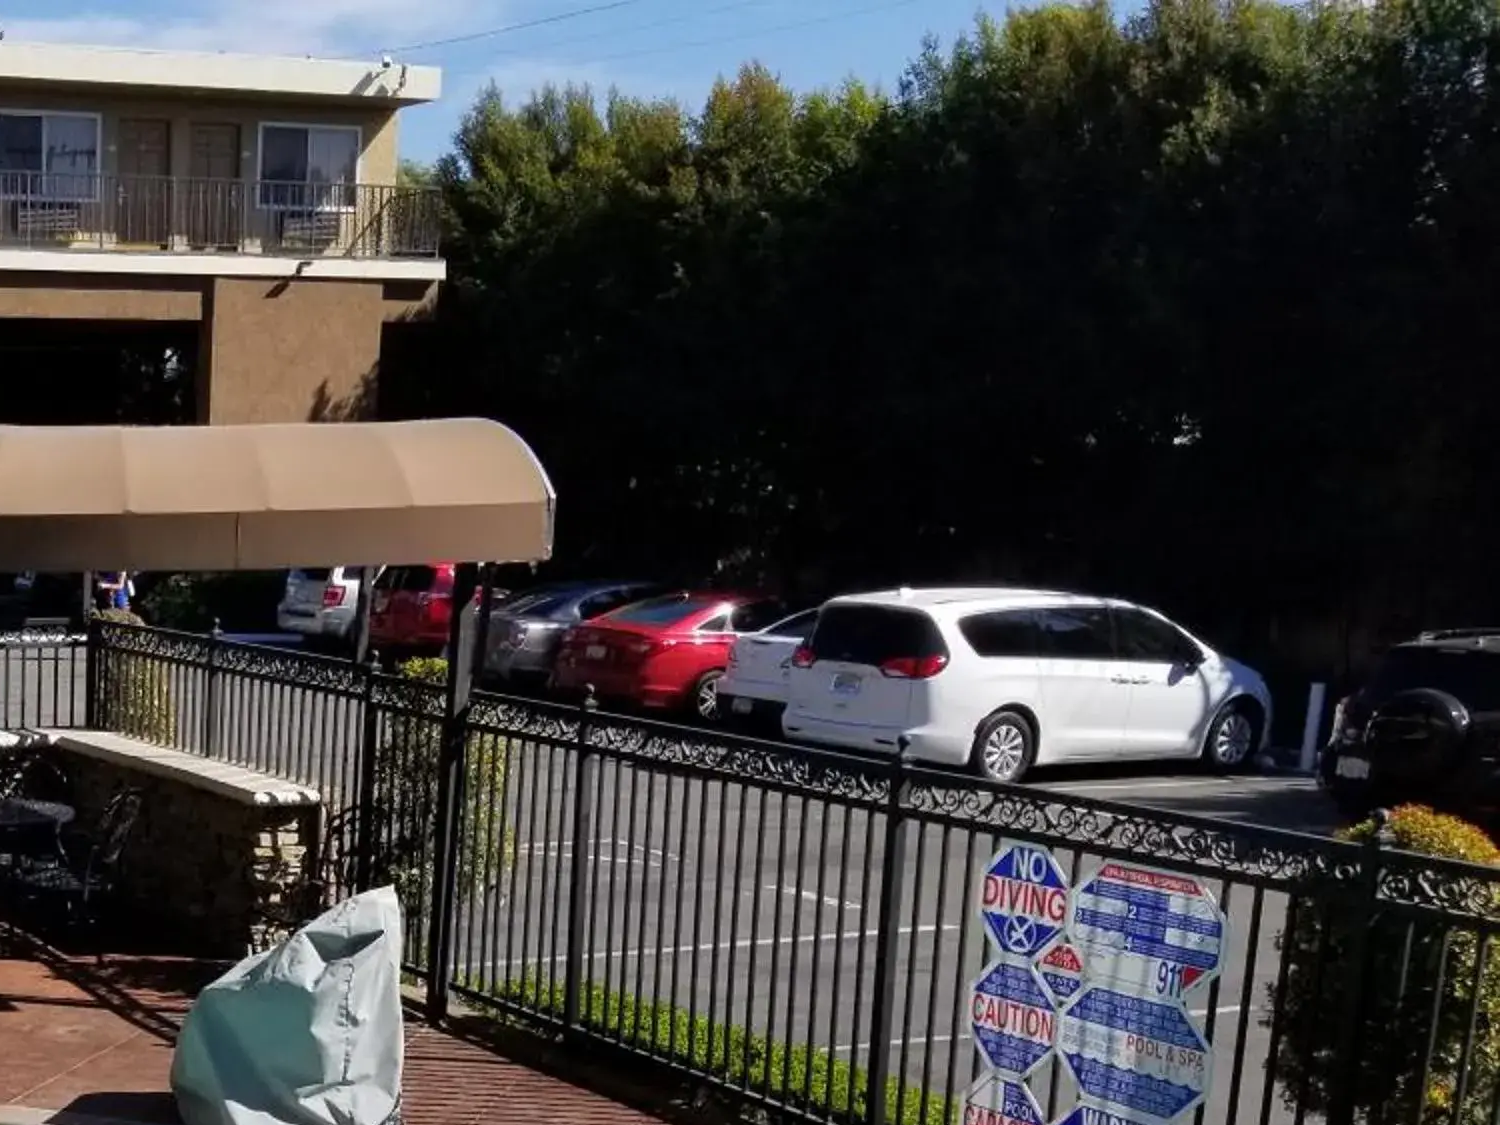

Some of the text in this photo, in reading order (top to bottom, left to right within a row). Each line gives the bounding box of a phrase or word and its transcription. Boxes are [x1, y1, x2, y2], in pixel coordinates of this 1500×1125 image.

[1011, 847, 1047, 883] NO
[982, 875, 1067, 922] DIVING
[1156, 961, 1184, 997] 911
[972, 993, 1054, 1042] CAUTION
[1126, 1034, 1163, 1061] POOL
[1178, 1050, 1205, 1074] SPA
[1005, 1100, 1036, 1121] POOL
